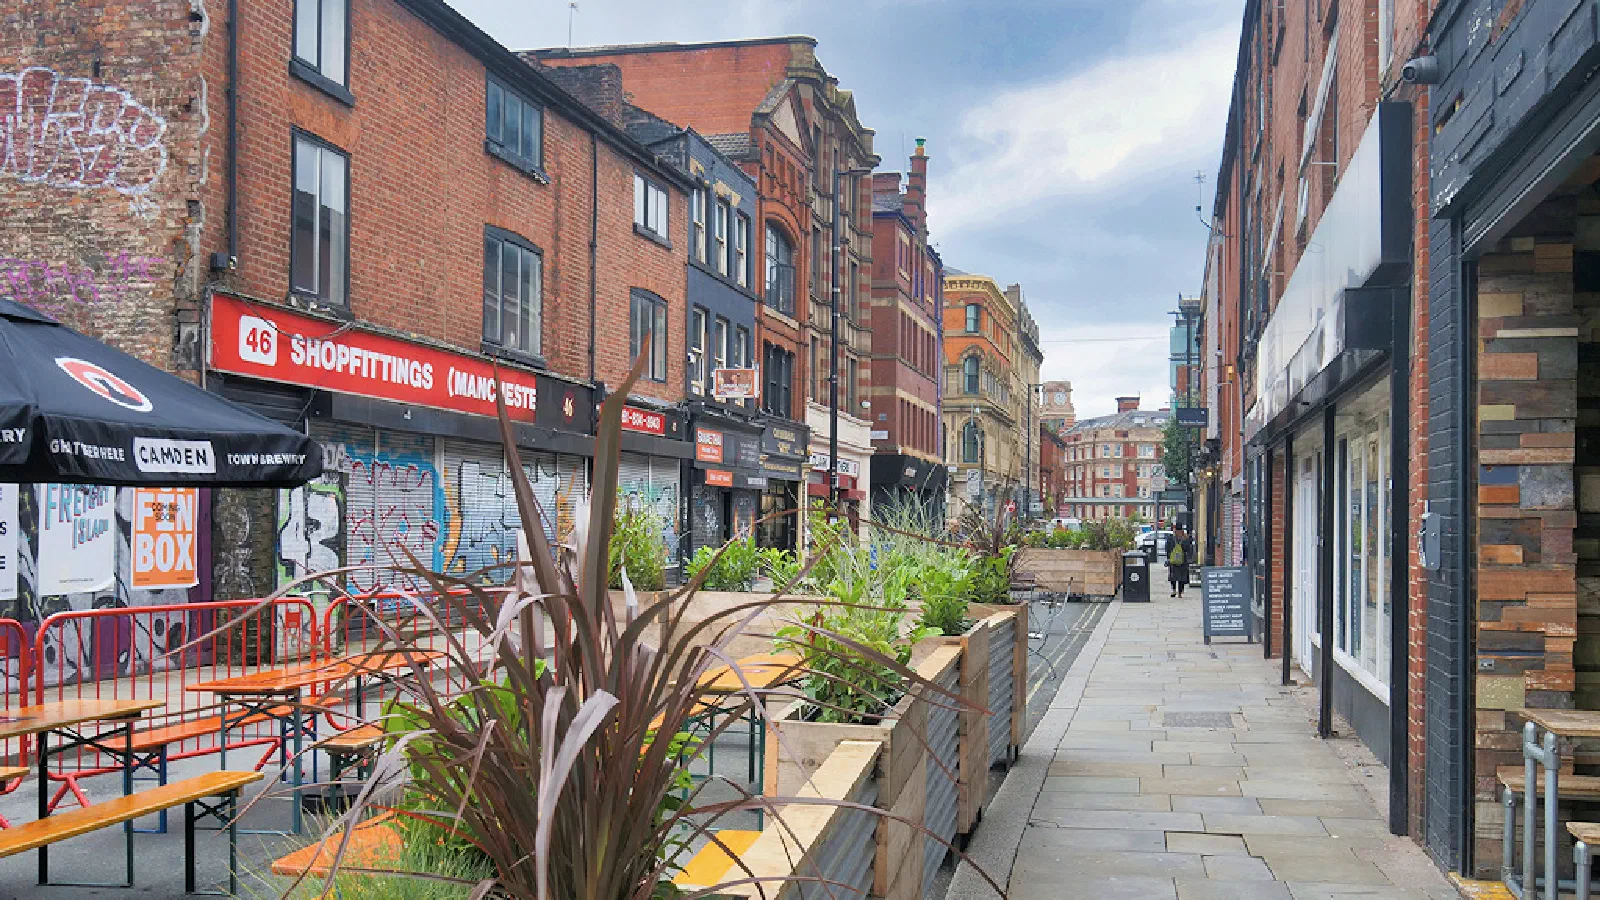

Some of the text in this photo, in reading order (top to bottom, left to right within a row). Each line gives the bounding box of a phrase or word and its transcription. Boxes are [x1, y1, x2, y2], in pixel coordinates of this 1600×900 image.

[246, 327, 272, 355] 46
[290, 333, 434, 390] SHOPFITTINGS
[0, 427, 26, 443] RY
[139, 444, 209, 467] CAMDEN
[227, 452, 259, 465] TOWN
[151, 502, 180, 513] COMING
[155, 512, 176, 521] SOON
[135, 533, 194, 573] BOX
